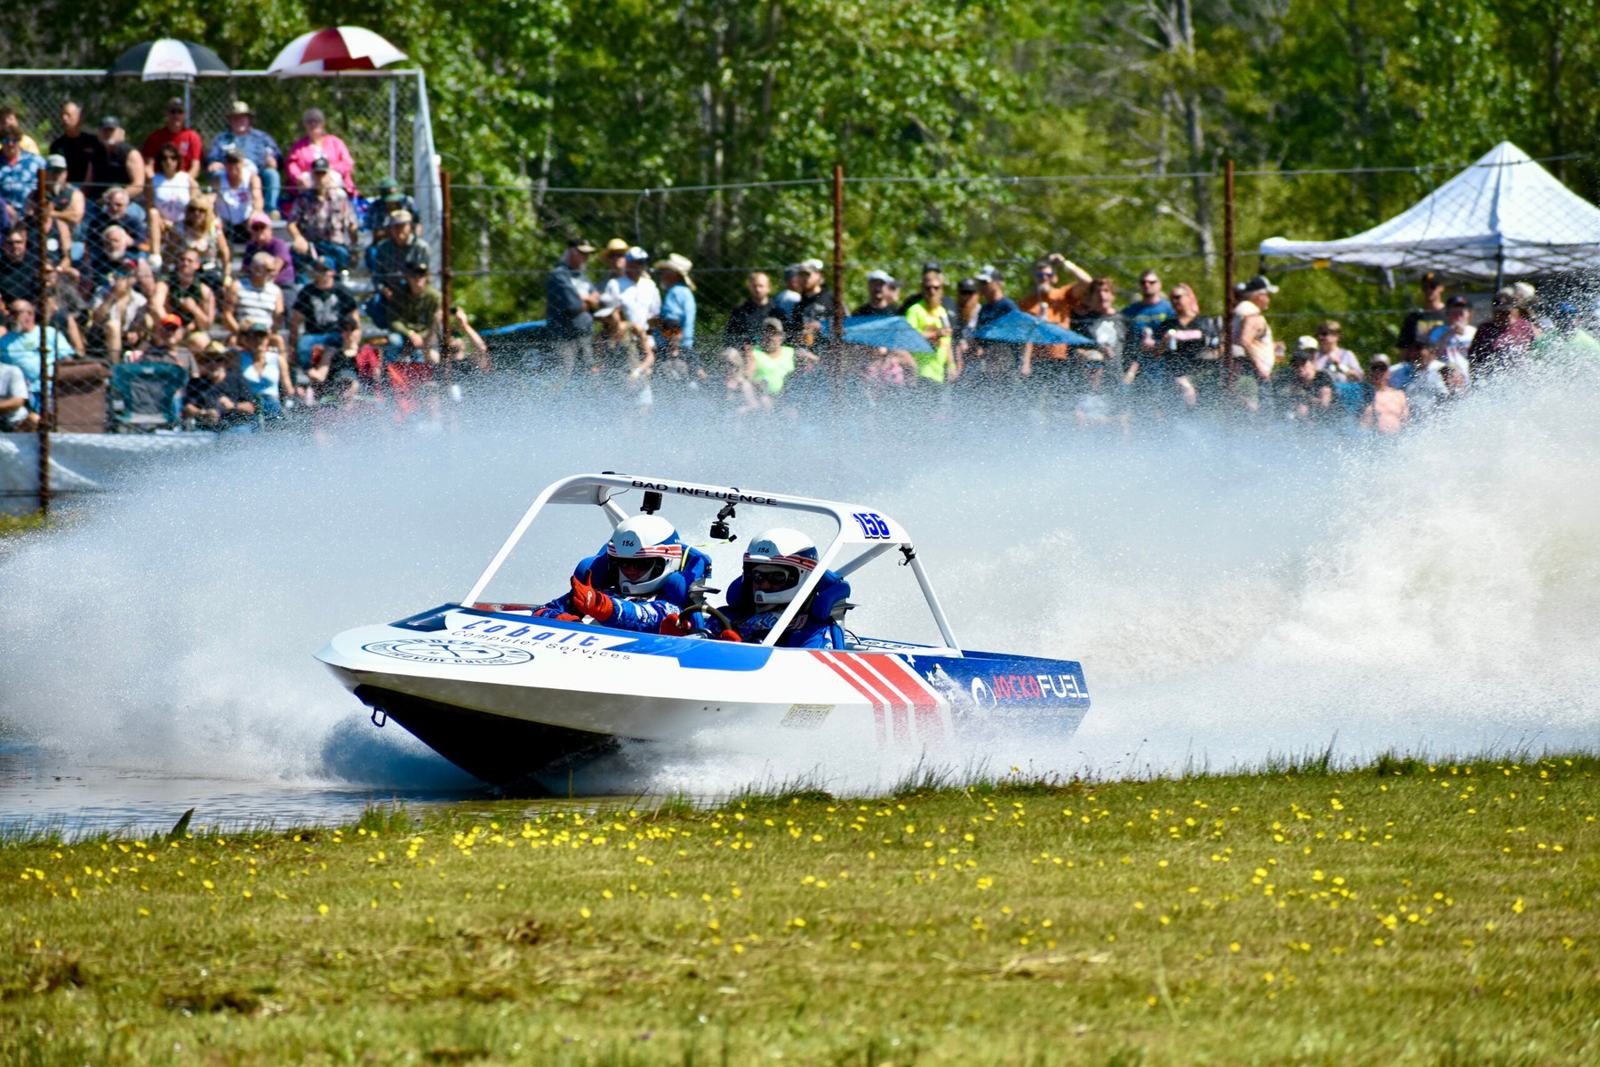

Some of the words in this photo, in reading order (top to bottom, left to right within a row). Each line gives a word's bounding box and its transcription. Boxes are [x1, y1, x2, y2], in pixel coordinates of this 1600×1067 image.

[631, 480, 669, 492] BAD
[676, 486, 777, 506] INFLUENCE
[852, 512, 891, 539] 156
[451, 630, 543, 647] Computer
[545, 643, 632, 660] Services
[462, 619, 600, 647] Cobalt
